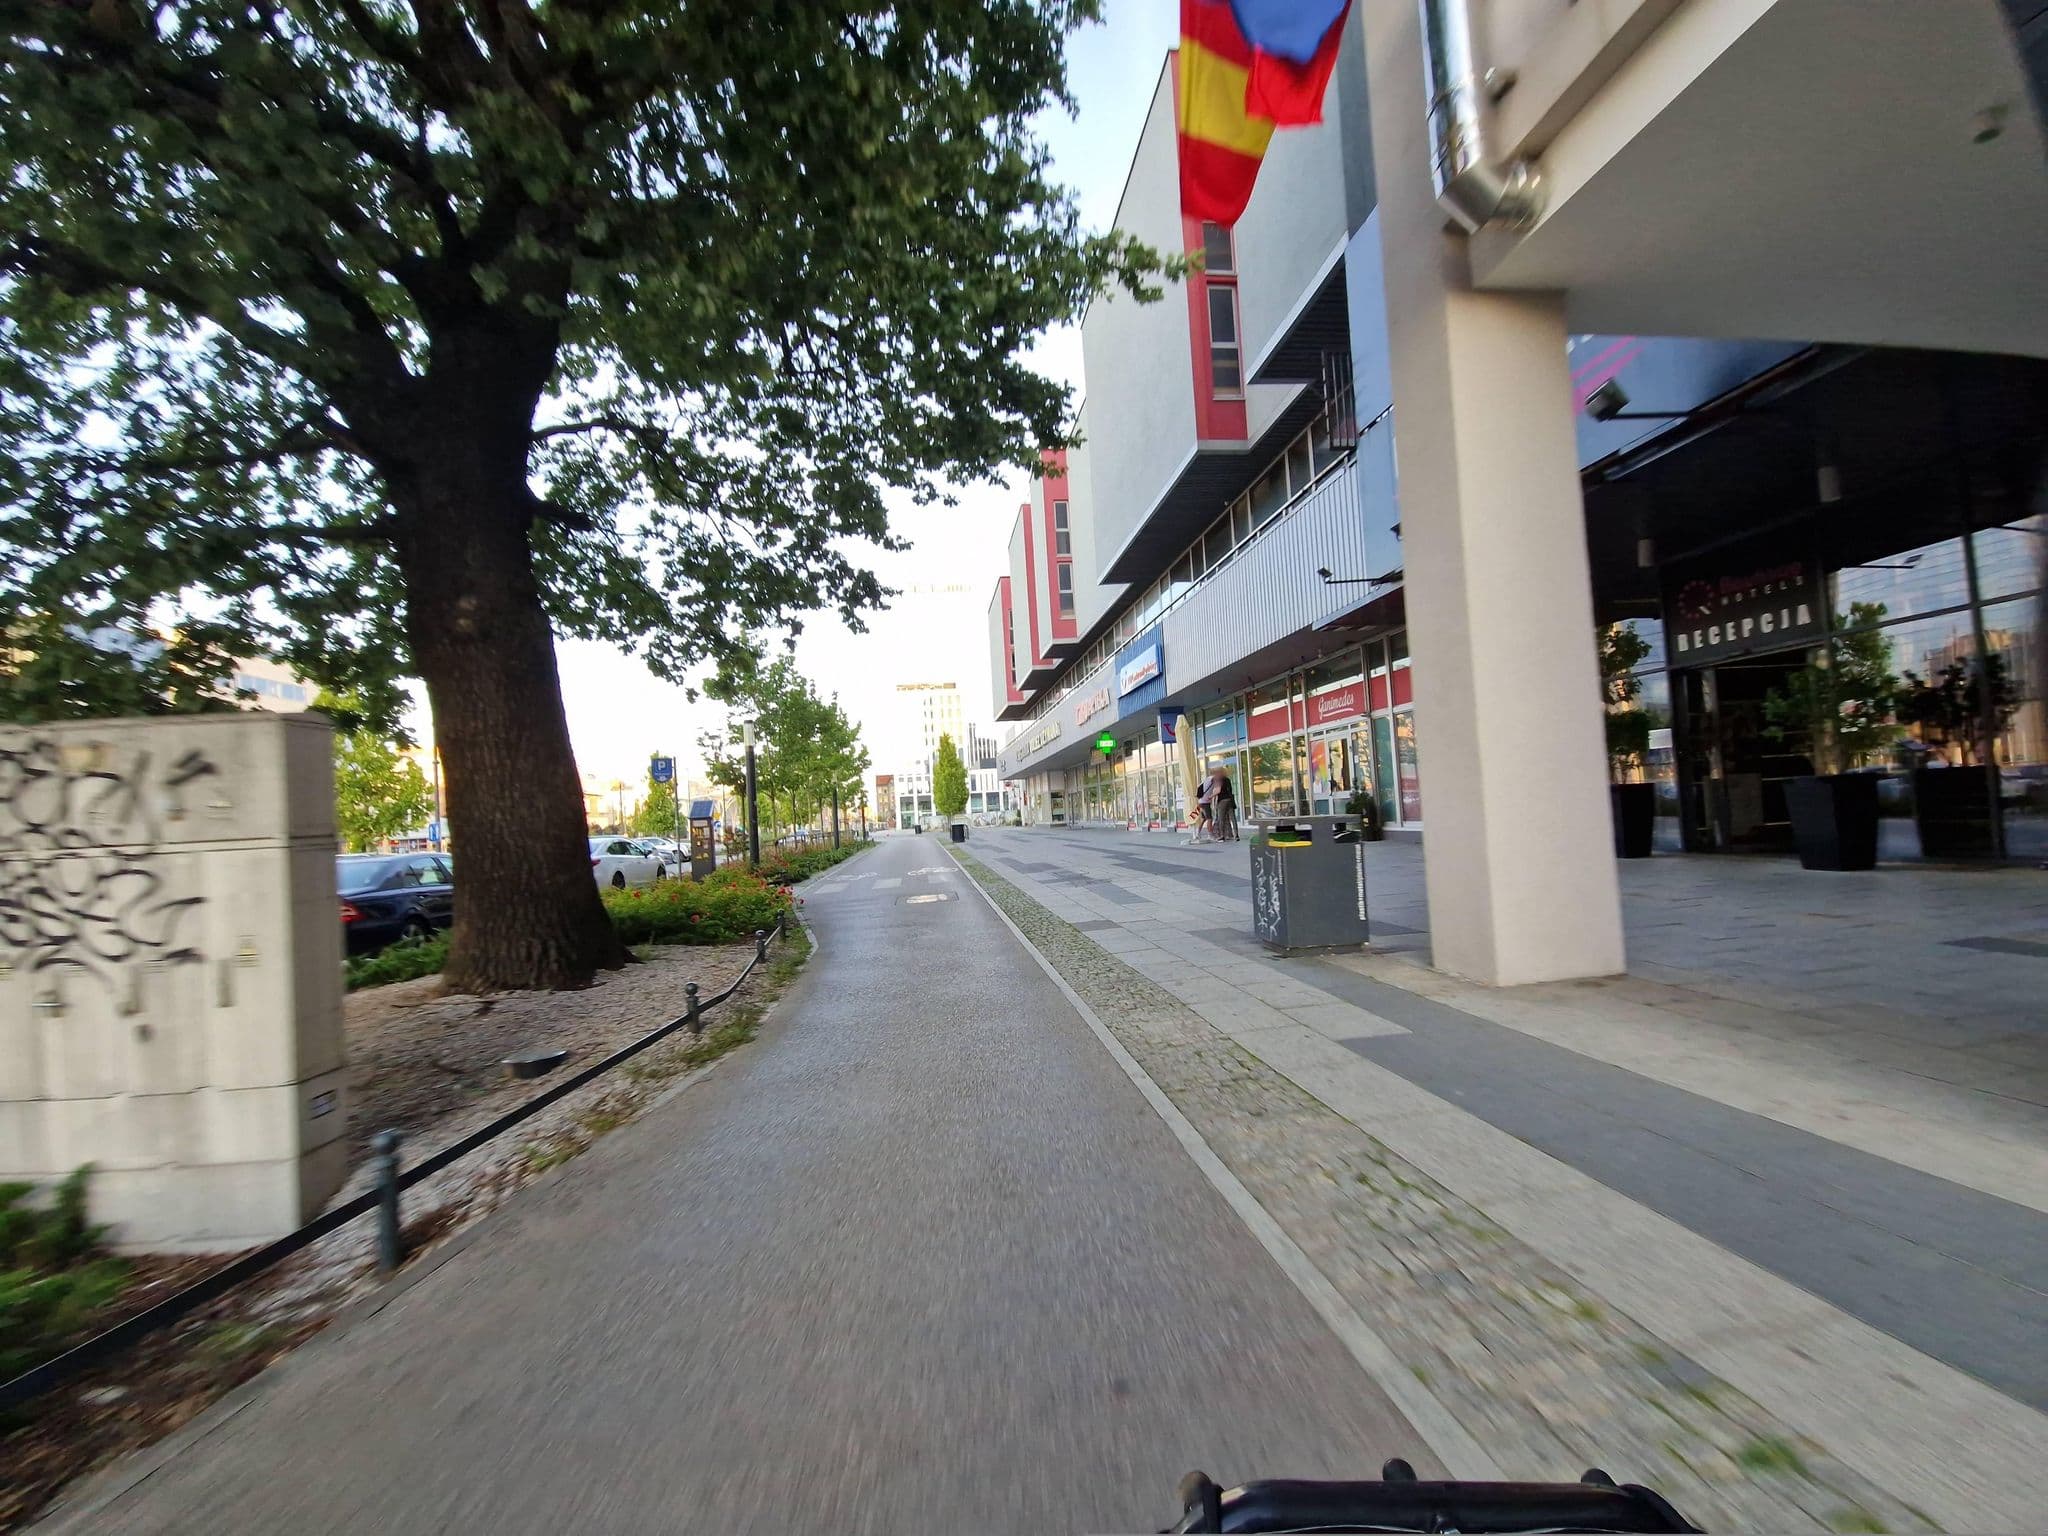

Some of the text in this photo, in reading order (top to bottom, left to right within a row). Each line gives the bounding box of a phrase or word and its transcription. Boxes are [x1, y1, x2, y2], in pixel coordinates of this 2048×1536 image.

[1677, 604, 1811, 652] RECEPCJA
[1318, 690, 1354, 720] Ganimedes
[658, 760, 666, 771] P
